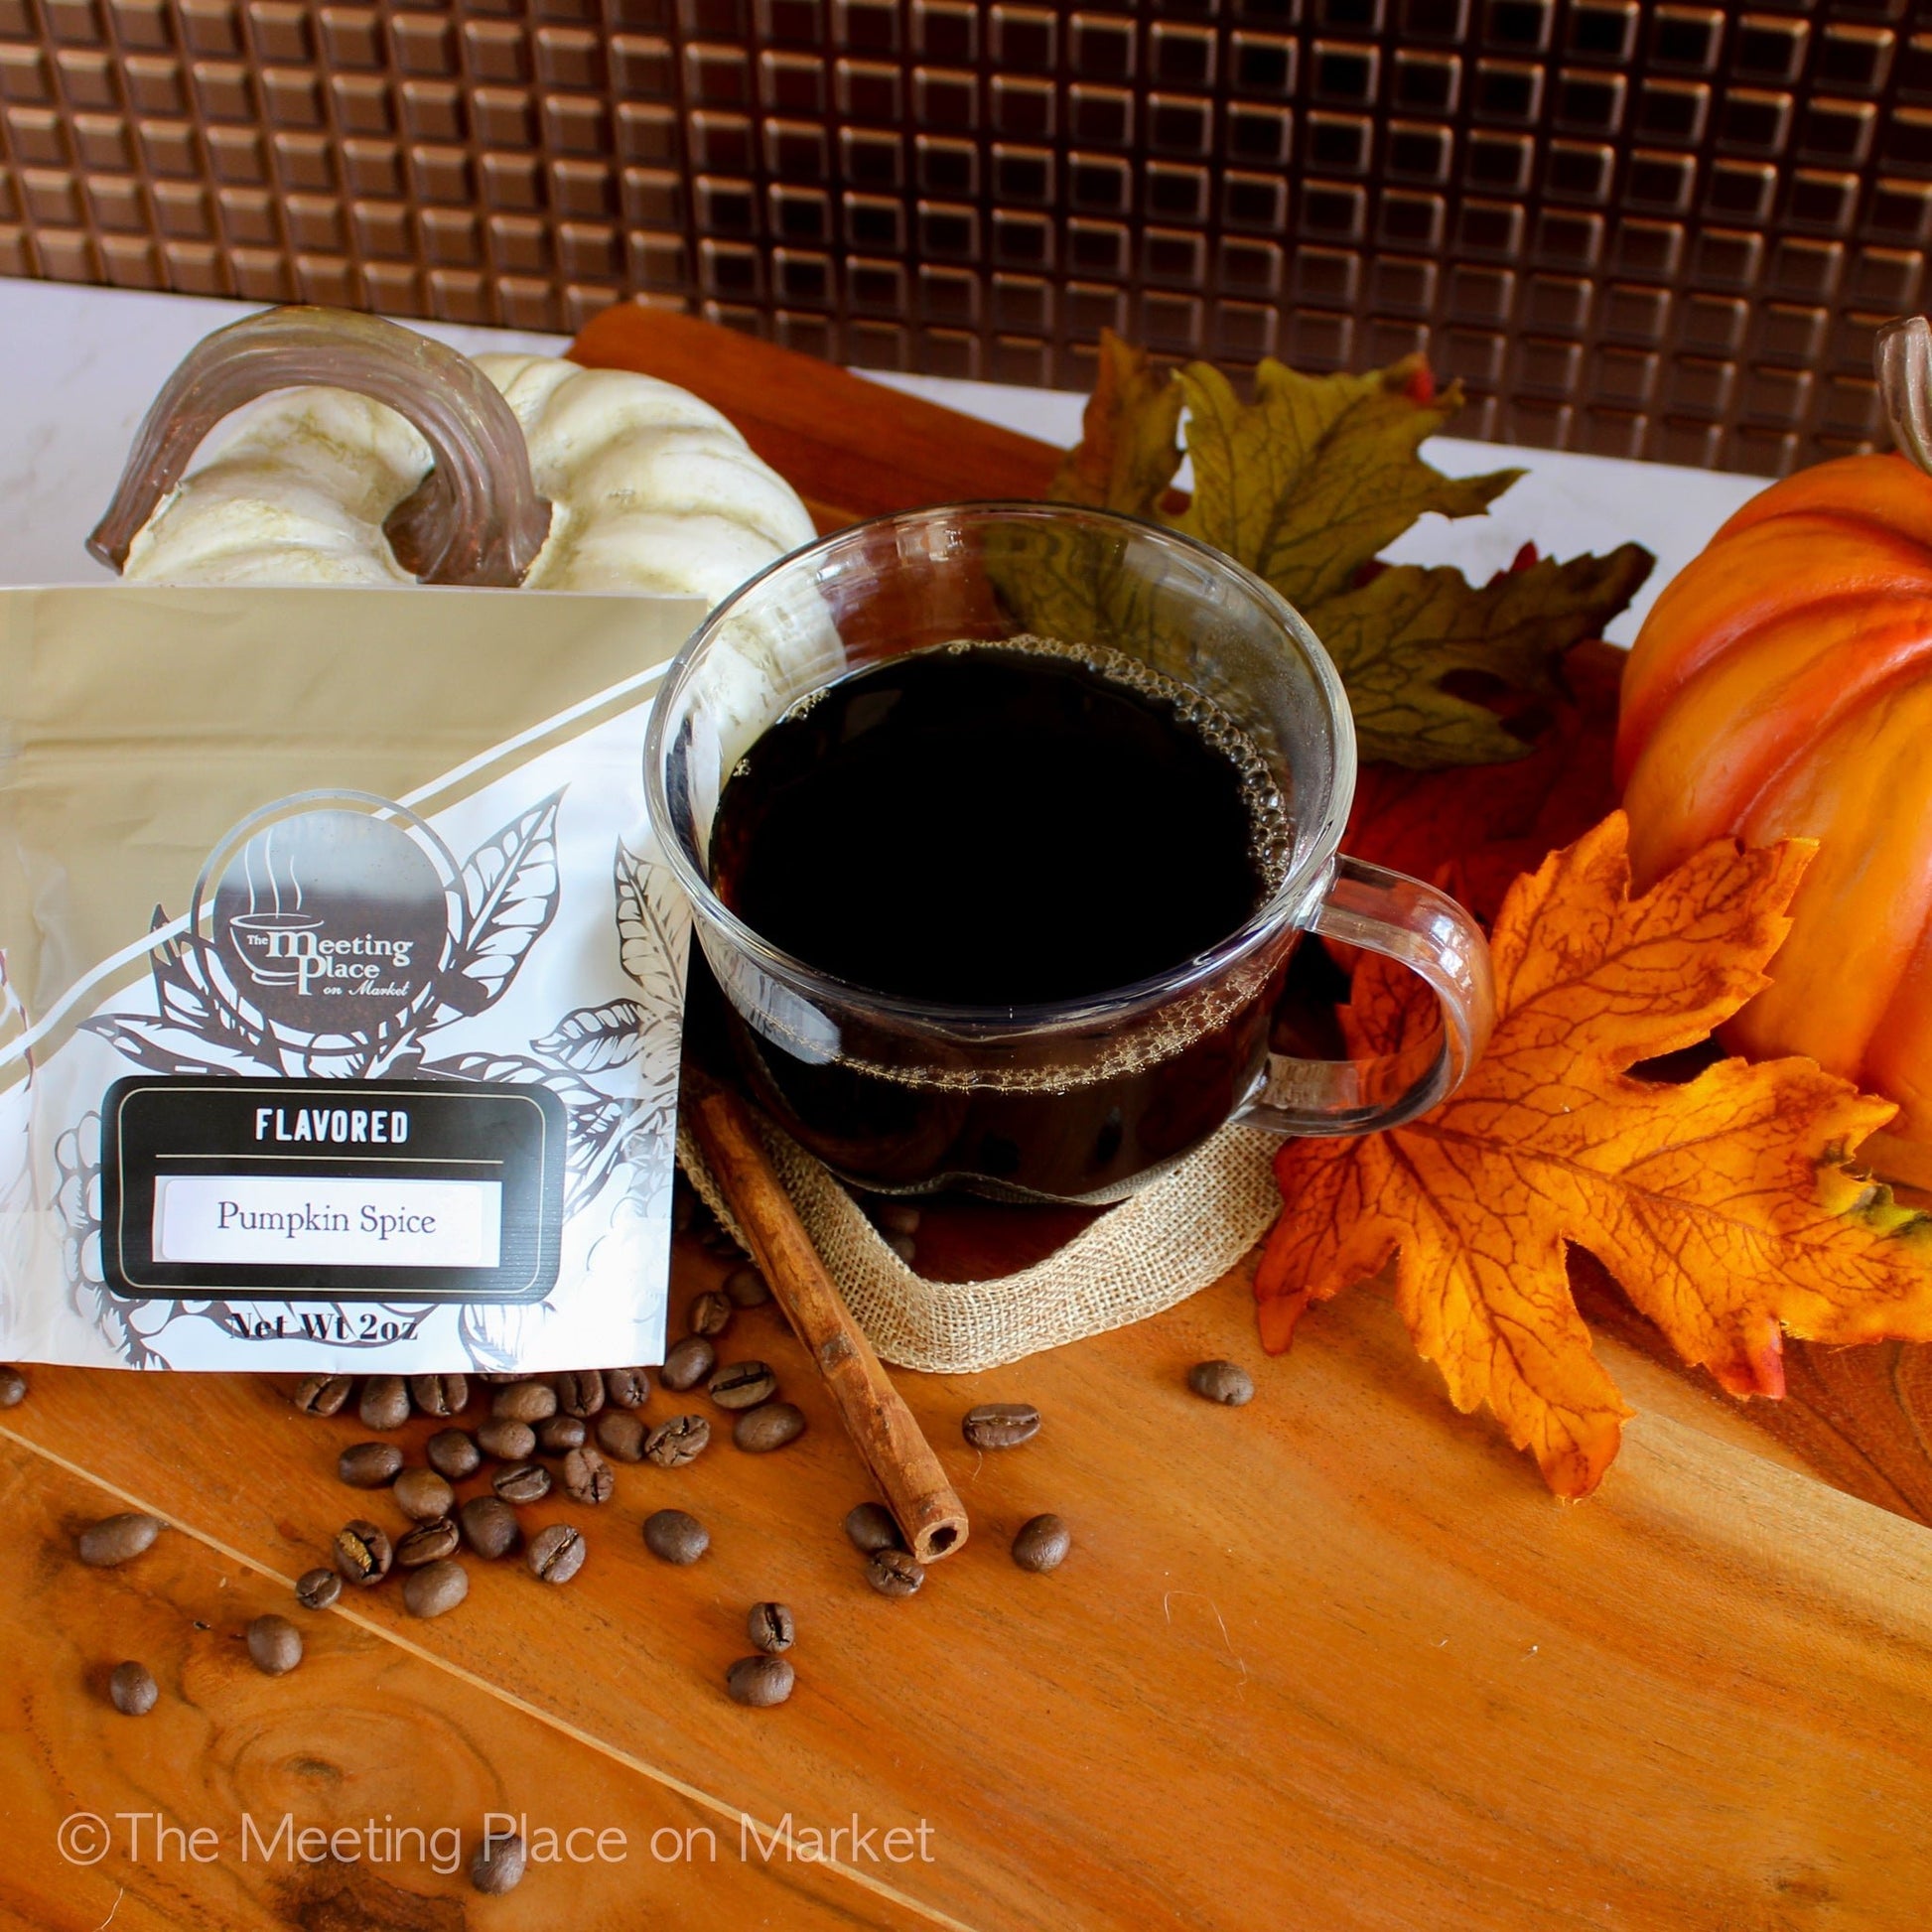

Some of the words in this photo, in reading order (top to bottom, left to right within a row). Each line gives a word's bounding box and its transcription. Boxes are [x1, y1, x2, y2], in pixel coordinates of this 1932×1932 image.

[246, 934, 269, 946] The
[265, 931, 414, 967] Meeting
[298, 955, 380, 996] Place
[348, 979, 410, 997] Market
[255, 1108, 409, 1144] FLAVORED
[217, 1201, 349, 1238] Pumpkin
[360, 1205, 436, 1240] Spice
[229, 1312, 288, 1339] Net
[299, 1312, 348, 1340] Wt
[359, 1312, 418, 1340] 2oz
